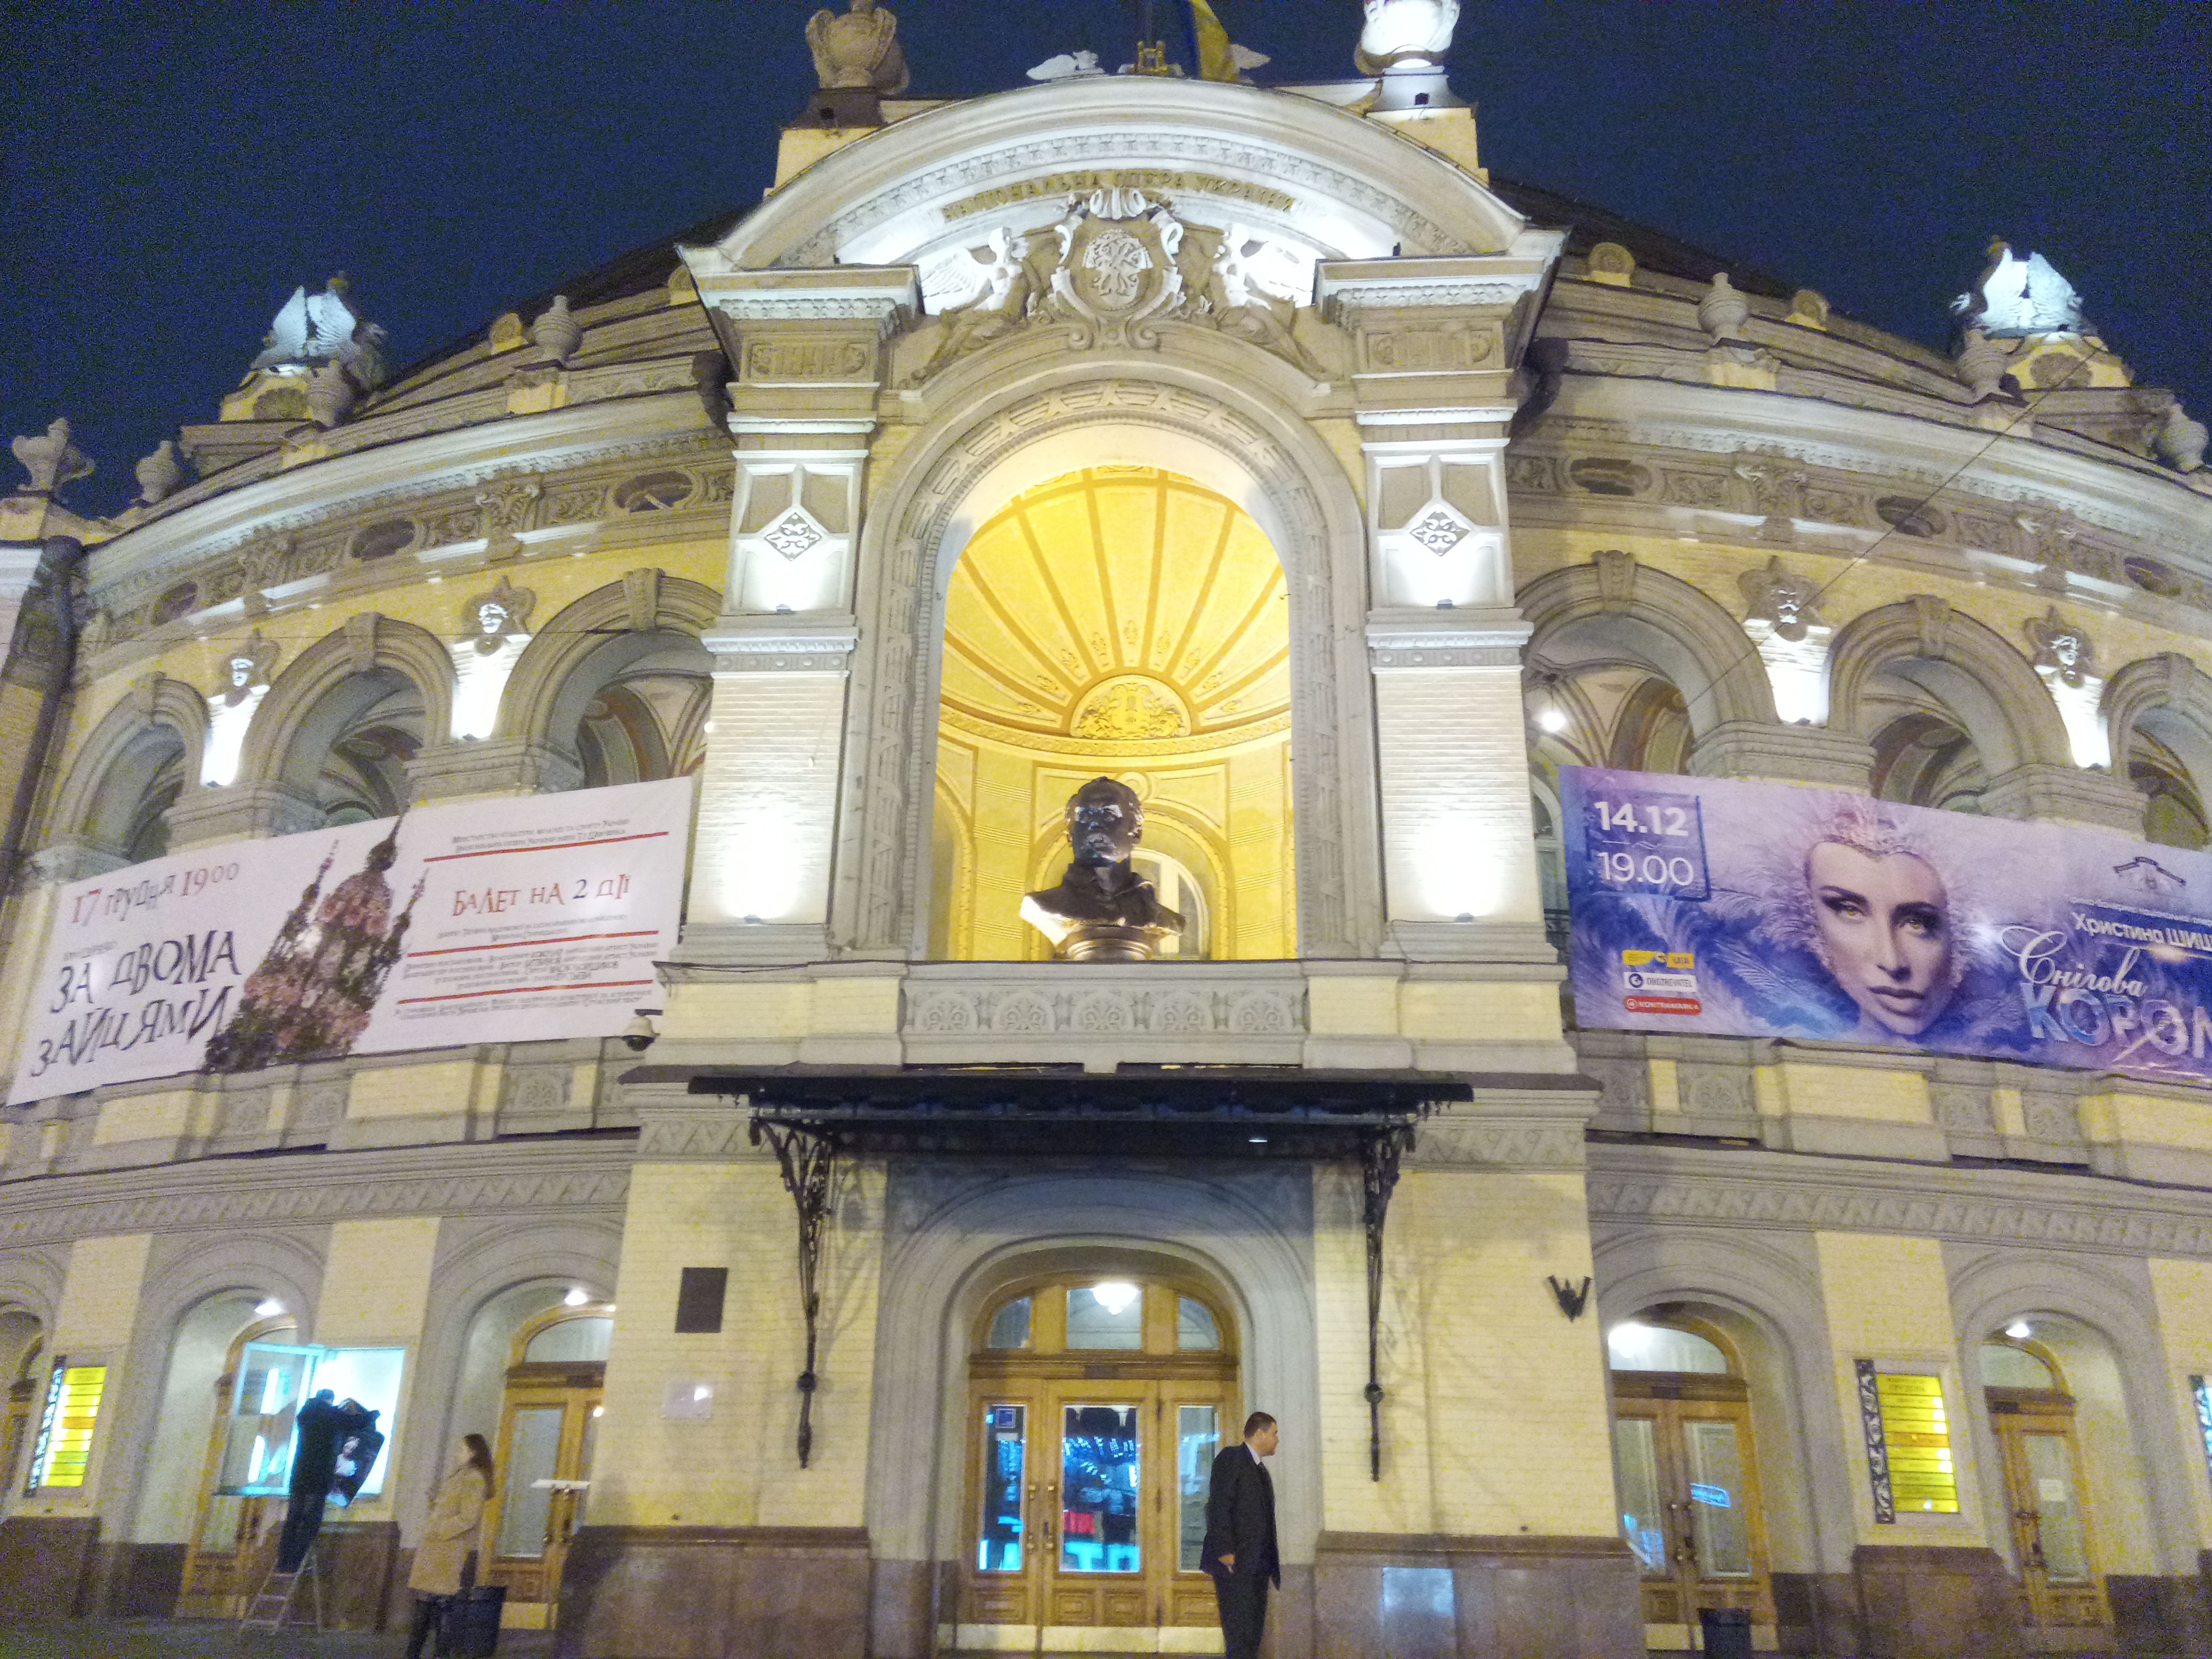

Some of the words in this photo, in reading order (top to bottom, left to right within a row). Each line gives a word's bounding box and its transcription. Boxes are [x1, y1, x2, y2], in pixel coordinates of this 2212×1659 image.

[1594, 801, 1689, 836] 14.12
[1597, 852, 1694, 885] 19.00
[73, 889, 103, 927] 17
[452, 886, 521, 916] БАЛЕТ
[530, 883, 565, 905] НА
[572, 879, 588, 899] 2
[2072, 911, 2165, 944] Христина
[52, 962, 94, 1013] ЗА
[108, 929, 241, 996] ДВОМА
[2001, 925, 2148, 998] Снігова
